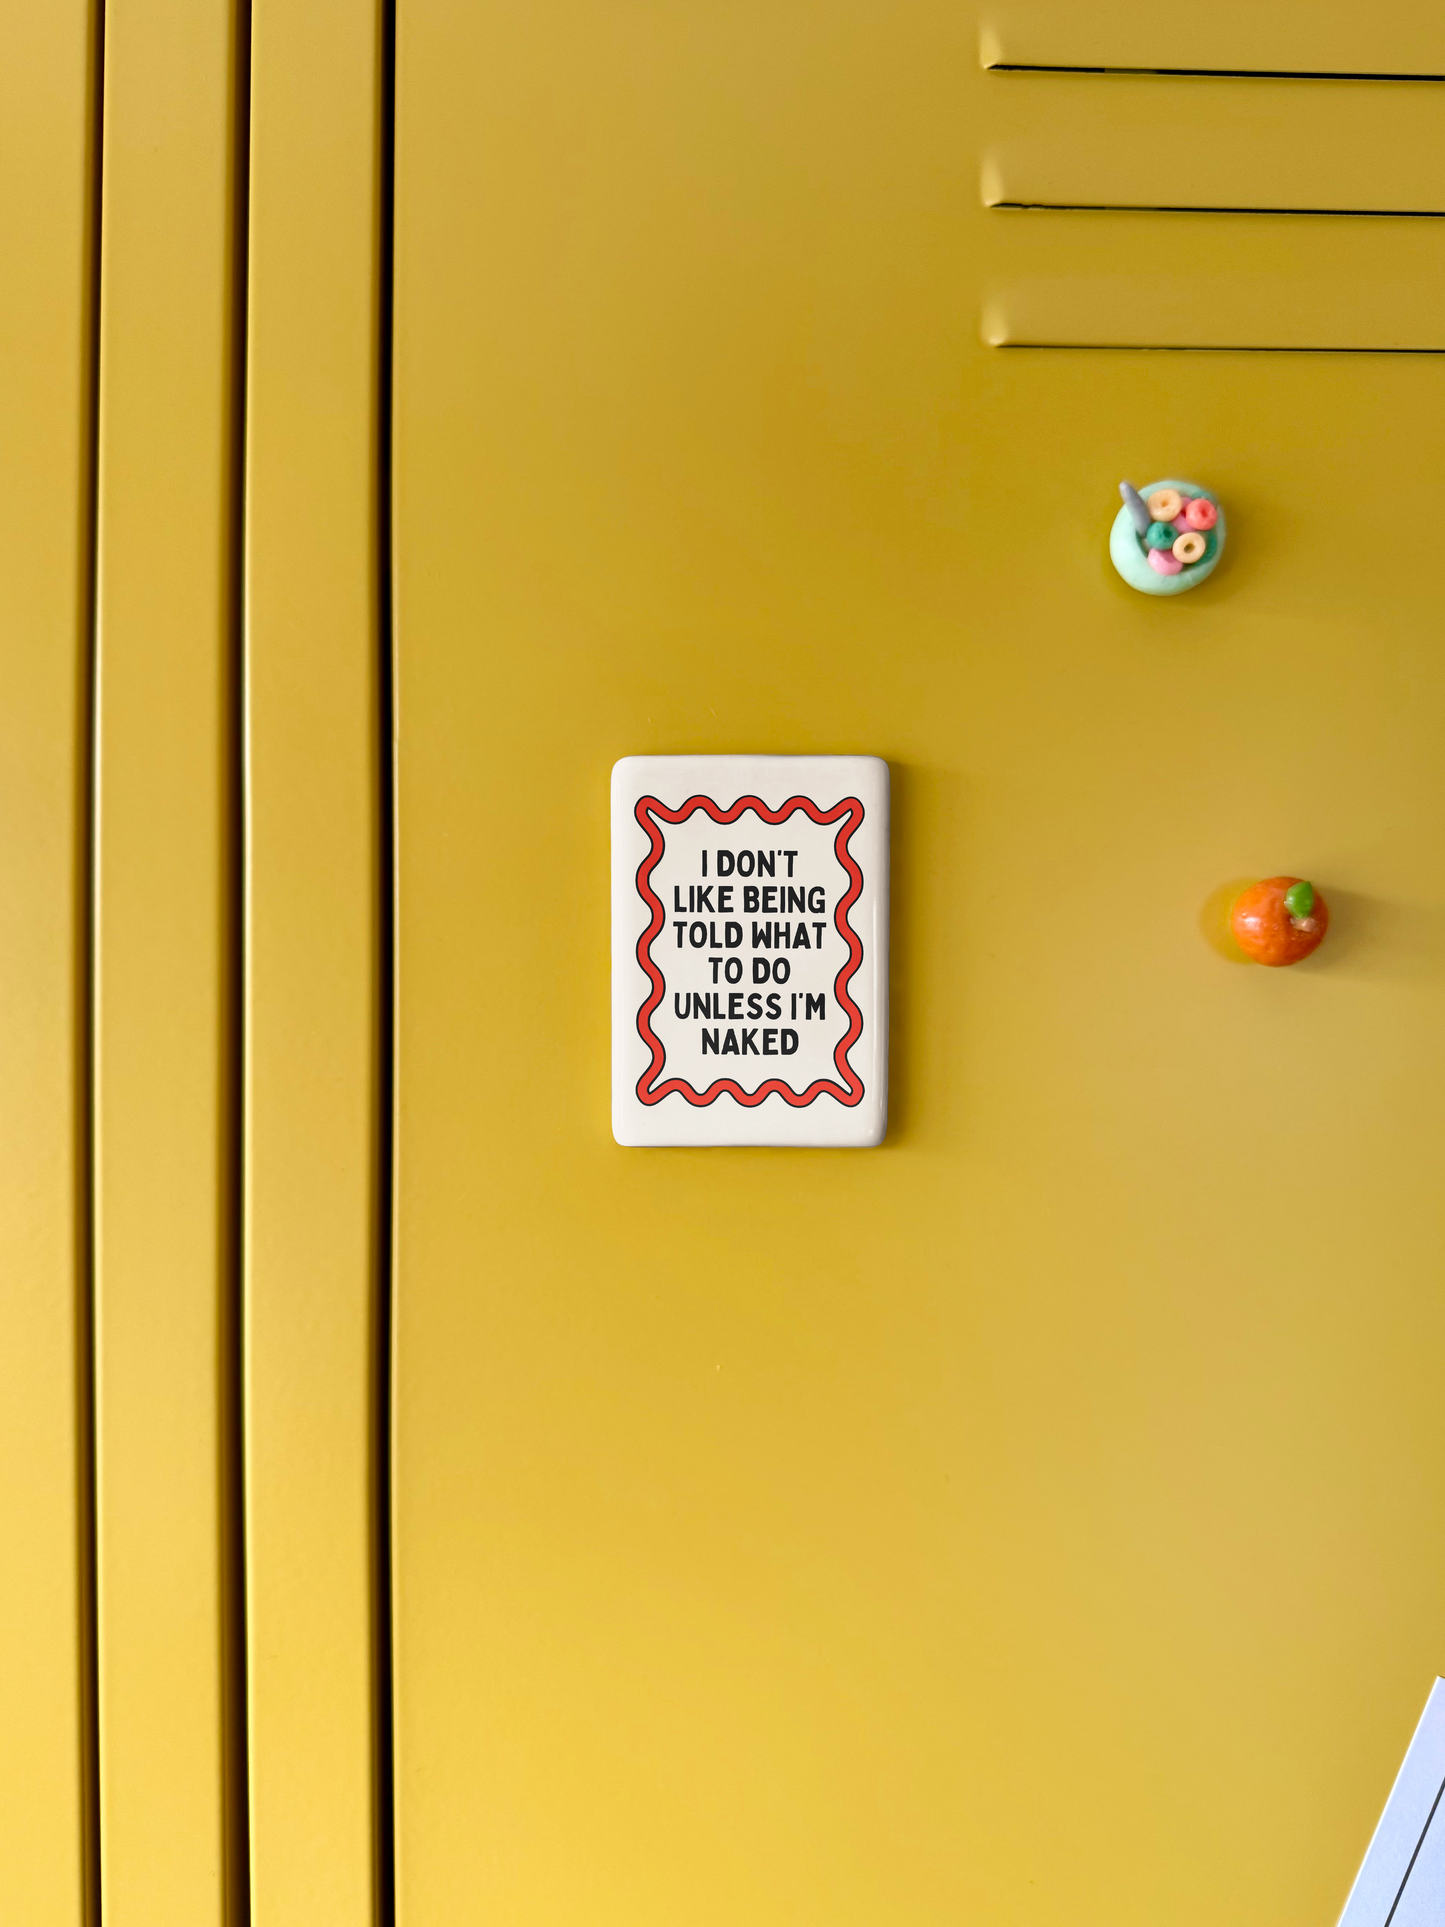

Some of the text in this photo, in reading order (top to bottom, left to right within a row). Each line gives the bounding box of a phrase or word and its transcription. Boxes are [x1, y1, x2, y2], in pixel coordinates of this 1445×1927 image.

[701, 849, 799, 878] I DON'T
[674, 885, 826, 914] LIKE BEING
[672, 921, 827, 950] TOLD WHAT
[708, 956, 791, 985] TO DO
[674, 992, 826, 1021] UNLESS I'M
[701, 1027, 799, 1056] NAKED
